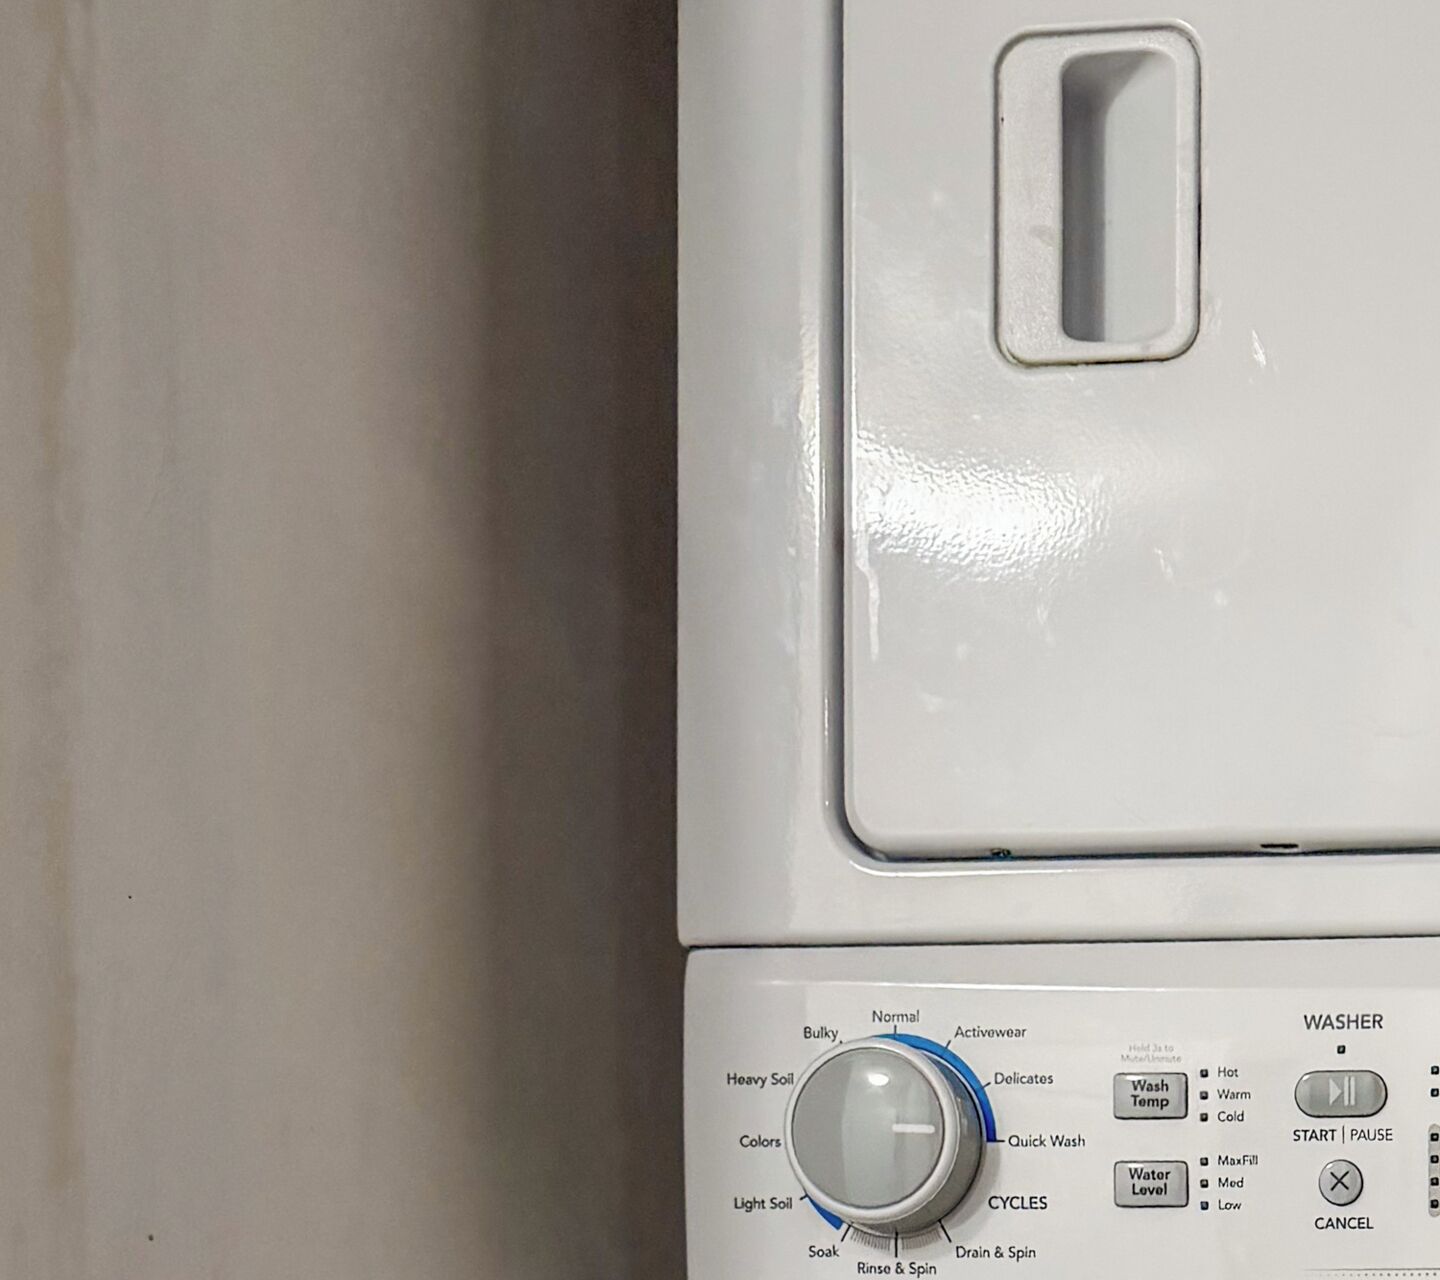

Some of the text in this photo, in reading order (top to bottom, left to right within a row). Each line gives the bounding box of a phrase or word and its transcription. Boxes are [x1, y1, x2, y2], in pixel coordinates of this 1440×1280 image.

[872, 1010, 919, 1023] Normal
[1304, 1014, 1383, 1030] WASHER
[804, 1026, 838, 1041] Bulky
[954, 1026, 1026, 1038] Activewear
[995, 1072, 1053, 1084] Delicates
[1218, 1067, 1238, 1077] Hot
[727, 1073, 794, 1088] Heavy Soil
[1131, 1080, 1169, 1110] Wash Temp
[1217, 1089, 1251, 1099] Warm
[1218, 1111, 1244, 1122] Cold
[739, 1135, 781, 1148] Colors
[1008, 1134, 1085, 1147] Quick Wash
[1293, 1129, 1393, 1141] START PAUSE
[1218, 1155, 1258, 1166] MaxFill
[1129, 1167, 1171, 1196] Water Level
[1218, 1177, 1243, 1188] Med
[734, 1197, 792, 1212] Light Soil
[988, 1196, 1047, 1210] CYCLES
[1219, 1200, 1241, 1210] Low
[1315, 1217, 1374, 1229] CANCEL
[809, 1245, 839, 1258] Soak
[956, 1246, 1036, 1262] Drain & Spin
[858, 1262, 936, 1278] Rinse & Spin
